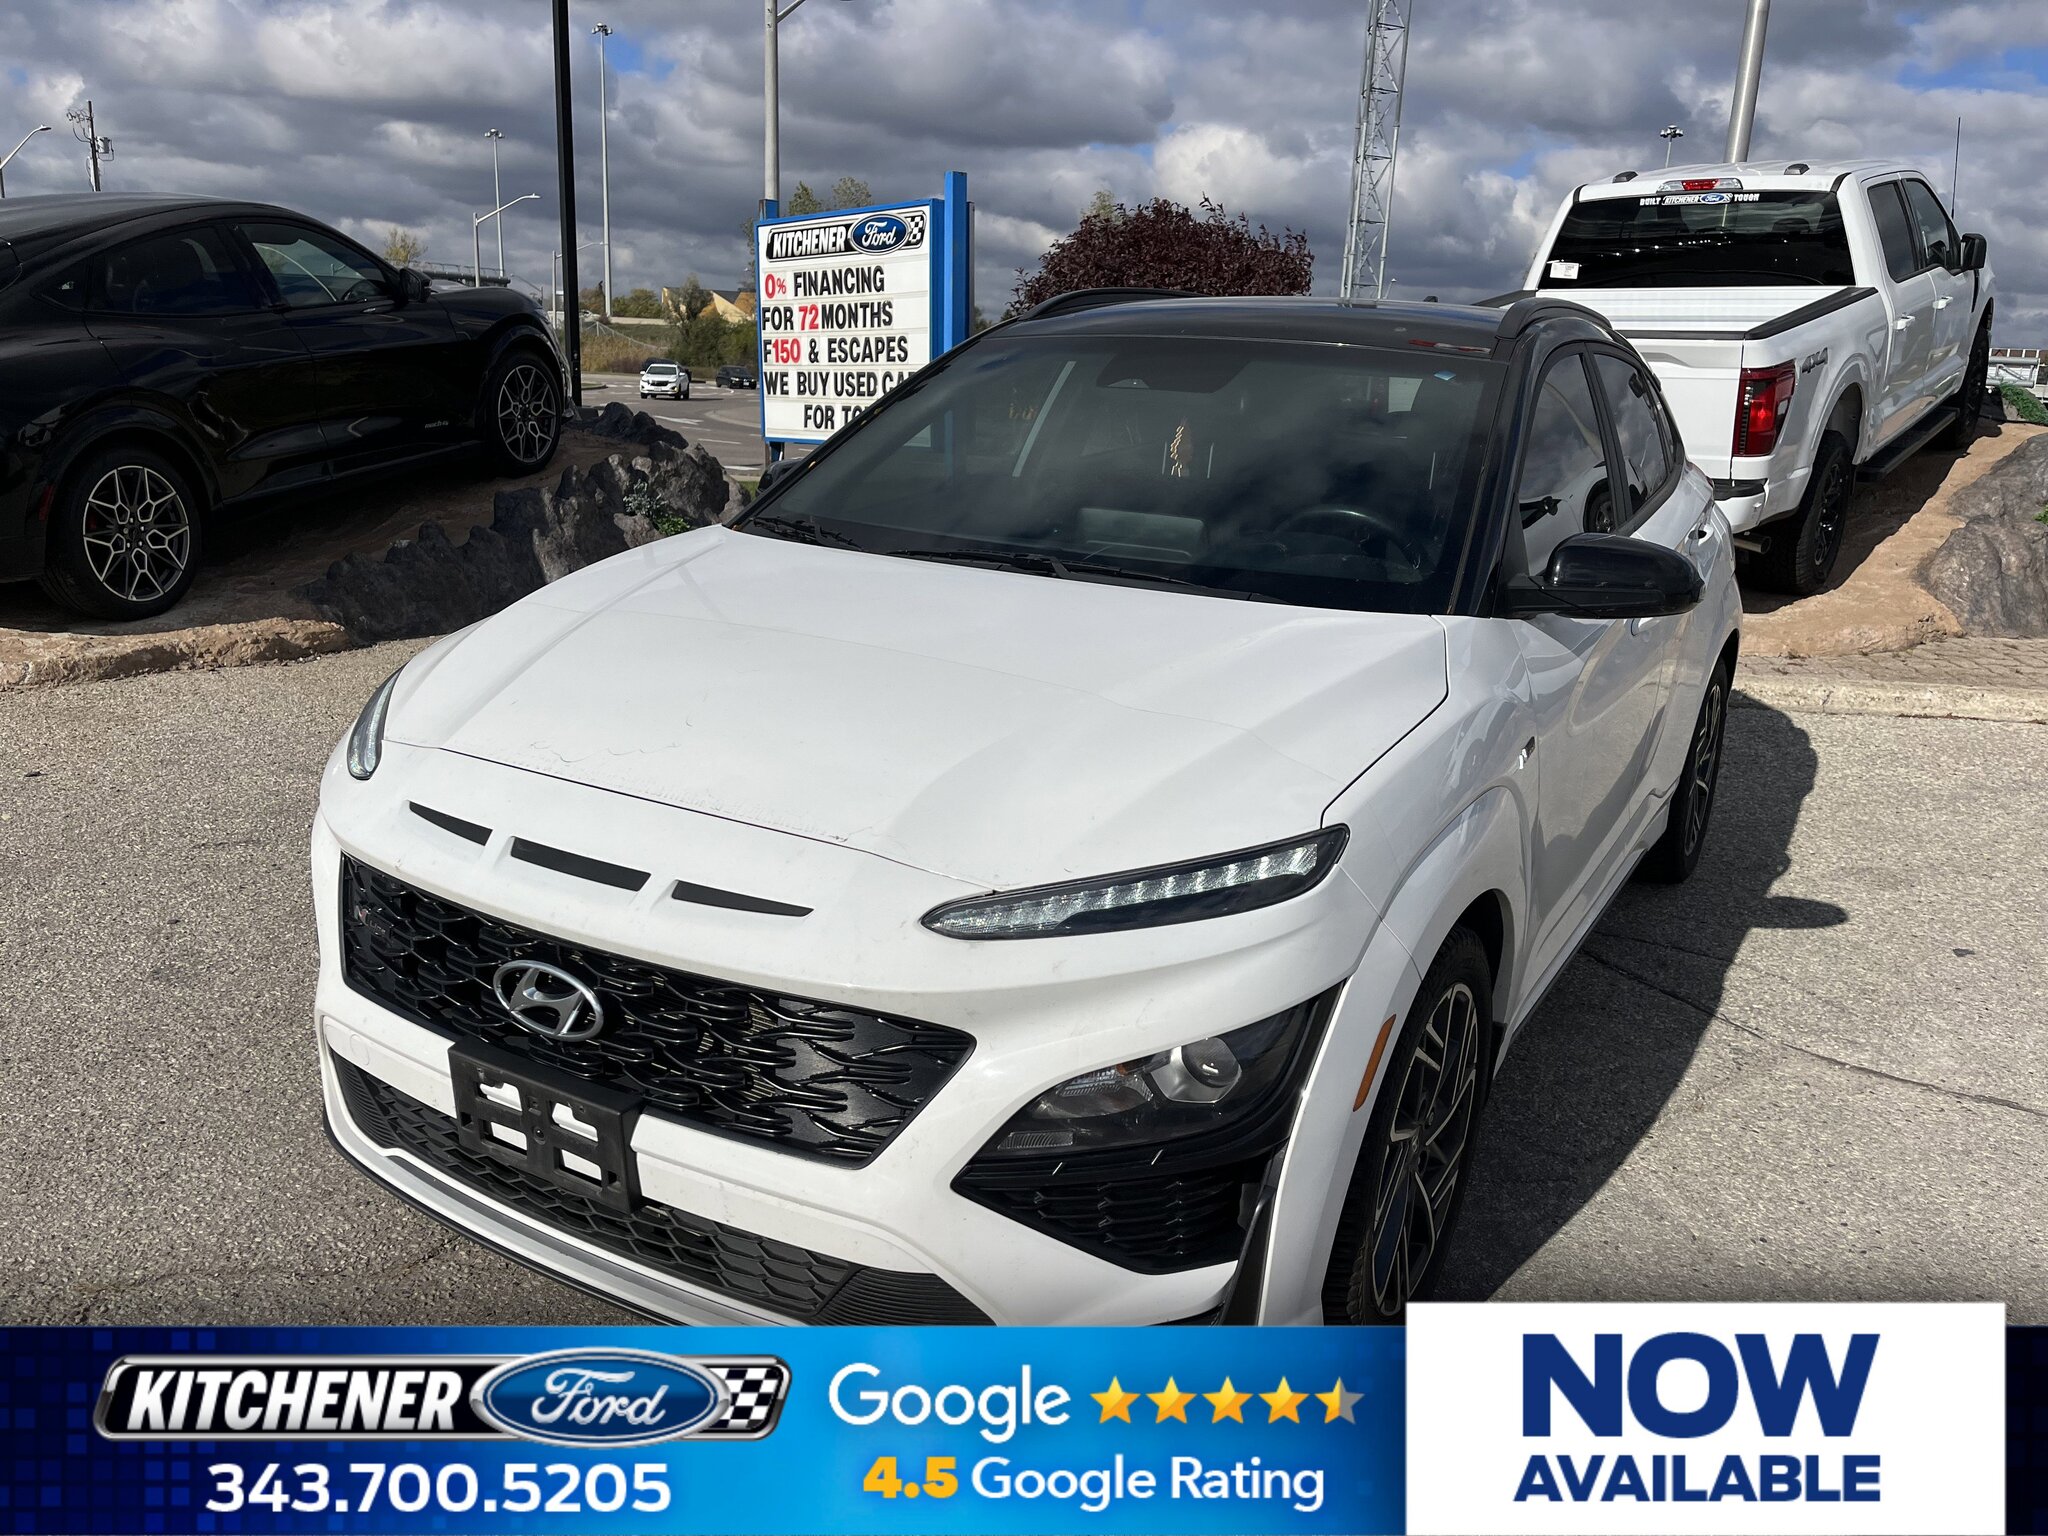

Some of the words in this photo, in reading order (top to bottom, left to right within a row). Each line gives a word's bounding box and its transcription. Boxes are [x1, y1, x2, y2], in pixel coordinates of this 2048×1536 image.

[772, 225, 847, 258] KITCHENER
[861, 220, 897, 247] Ford
[764, 273, 787, 299] 0%
[793, 265, 885, 297] FINANCING
[762, 306, 794, 331] FOR
[798, 304, 819, 331] 72
[821, 301, 893, 329] MONTHS
[763, 337, 801, 363] F150
[808, 340, 819, 363] &
[827, 335, 909, 363] ESCAPES
[764, 371, 789, 395] WE
[796, 371, 830, 396] BUY
[833, 371, 878, 397] USED
[804, 404, 835, 430] FOR
